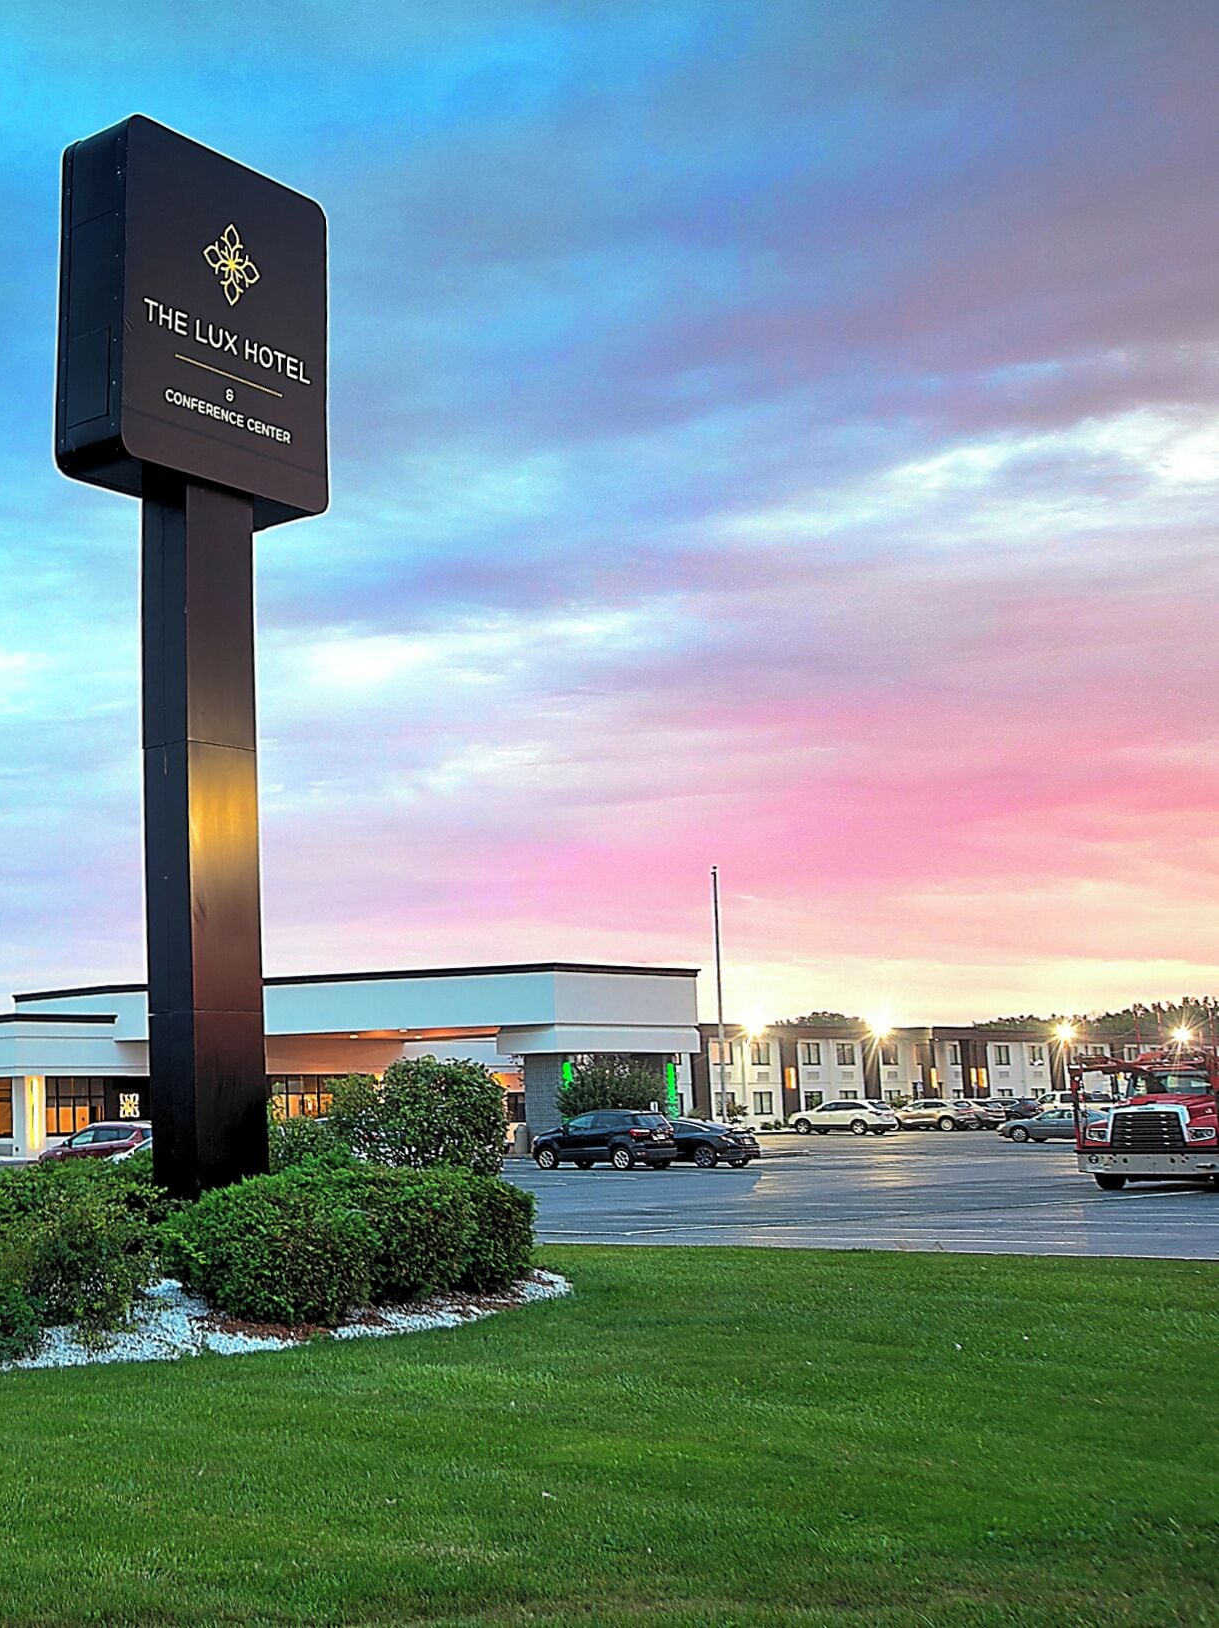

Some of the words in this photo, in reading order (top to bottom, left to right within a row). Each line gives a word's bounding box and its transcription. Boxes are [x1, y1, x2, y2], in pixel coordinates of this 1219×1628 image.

[143, 297, 188, 336] THE
[195, 319, 238, 356] LUX
[244, 339, 311, 385] HOTEL
[165, 388, 245, 428] CONFERENCE
[246, 418, 291, 444] CENTER
